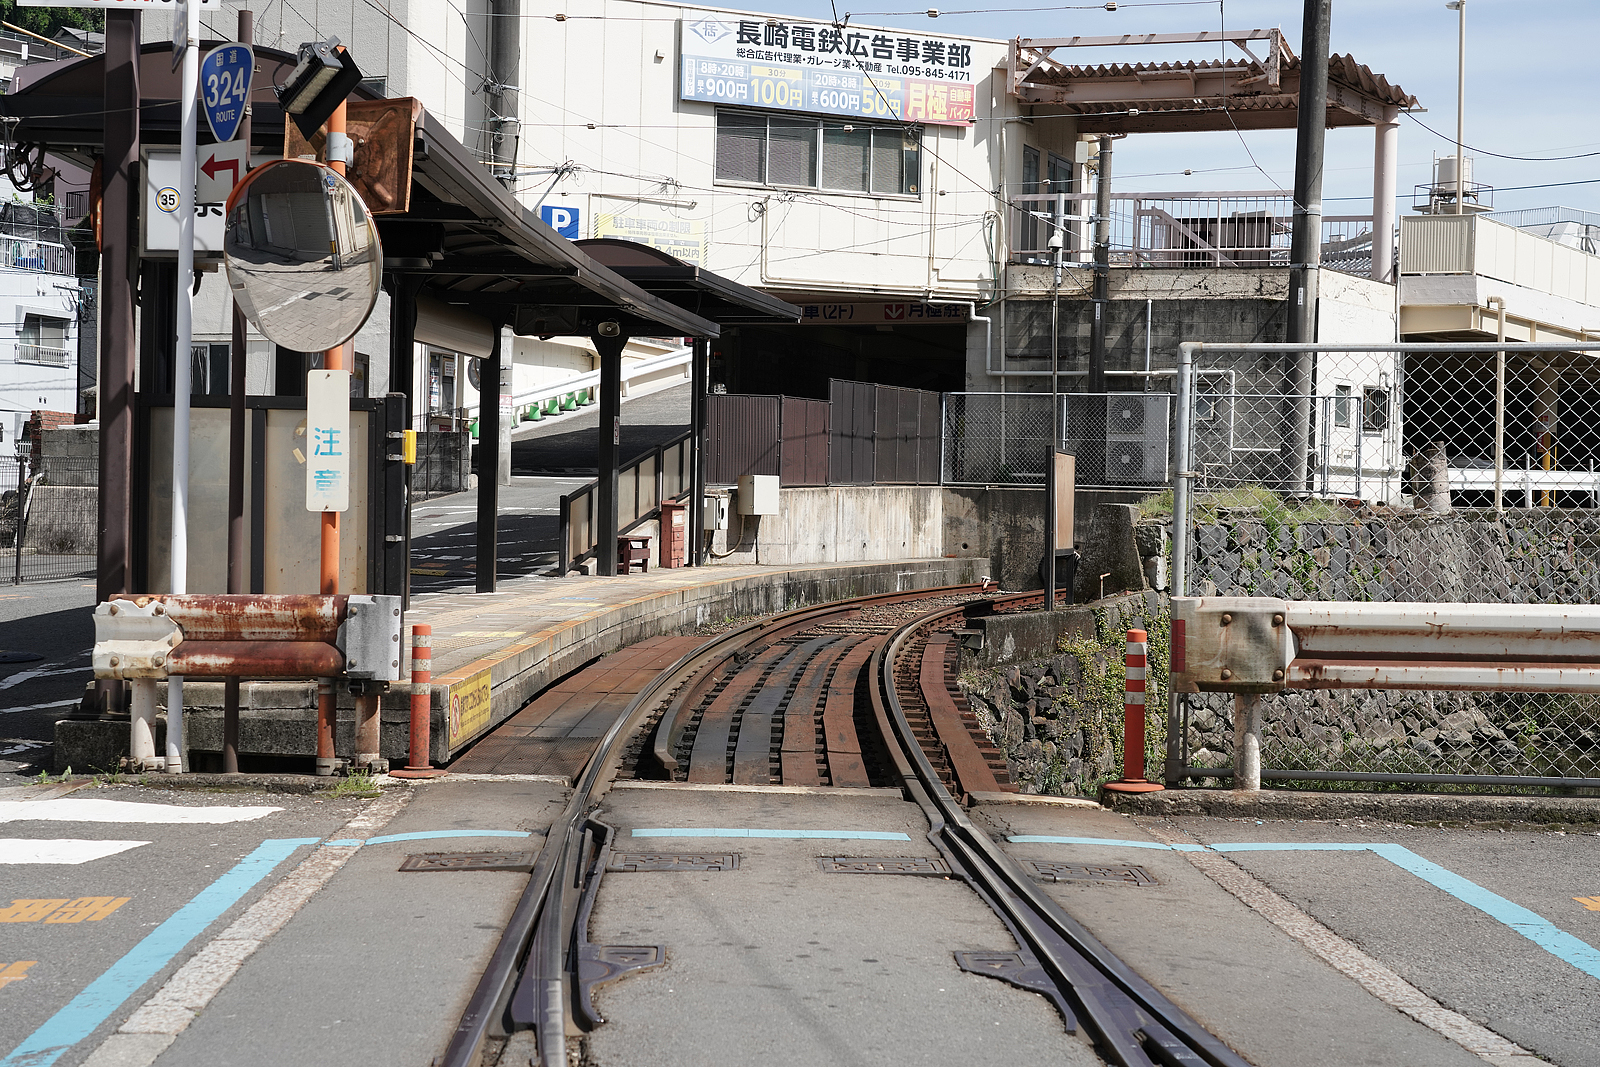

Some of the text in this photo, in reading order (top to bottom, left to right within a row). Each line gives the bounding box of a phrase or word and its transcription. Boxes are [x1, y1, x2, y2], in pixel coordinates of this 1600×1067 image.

[736, 20, 971, 68] 長崎電鉄広告事業部
[767, 68, 787, 78] 30分
[206, 67, 246, 108] 324
[705, 78, 748, 100] 900円
[750, 78, 803, 107] 100円
[950, 88, 972, 104] 自動車
[819, 90, 860, 111] 600円
[861, 89, 901, 117] 50円
[907, 82, 948, 120] 月極
[215, 109, 236, 123] ROUTE
[160, 194, 176, 206] 35
[551, 208, 571, 233] P
[612, 216, 691, 234] 駐車車両の制限
[908, 303, 966, 319] 月極駐
